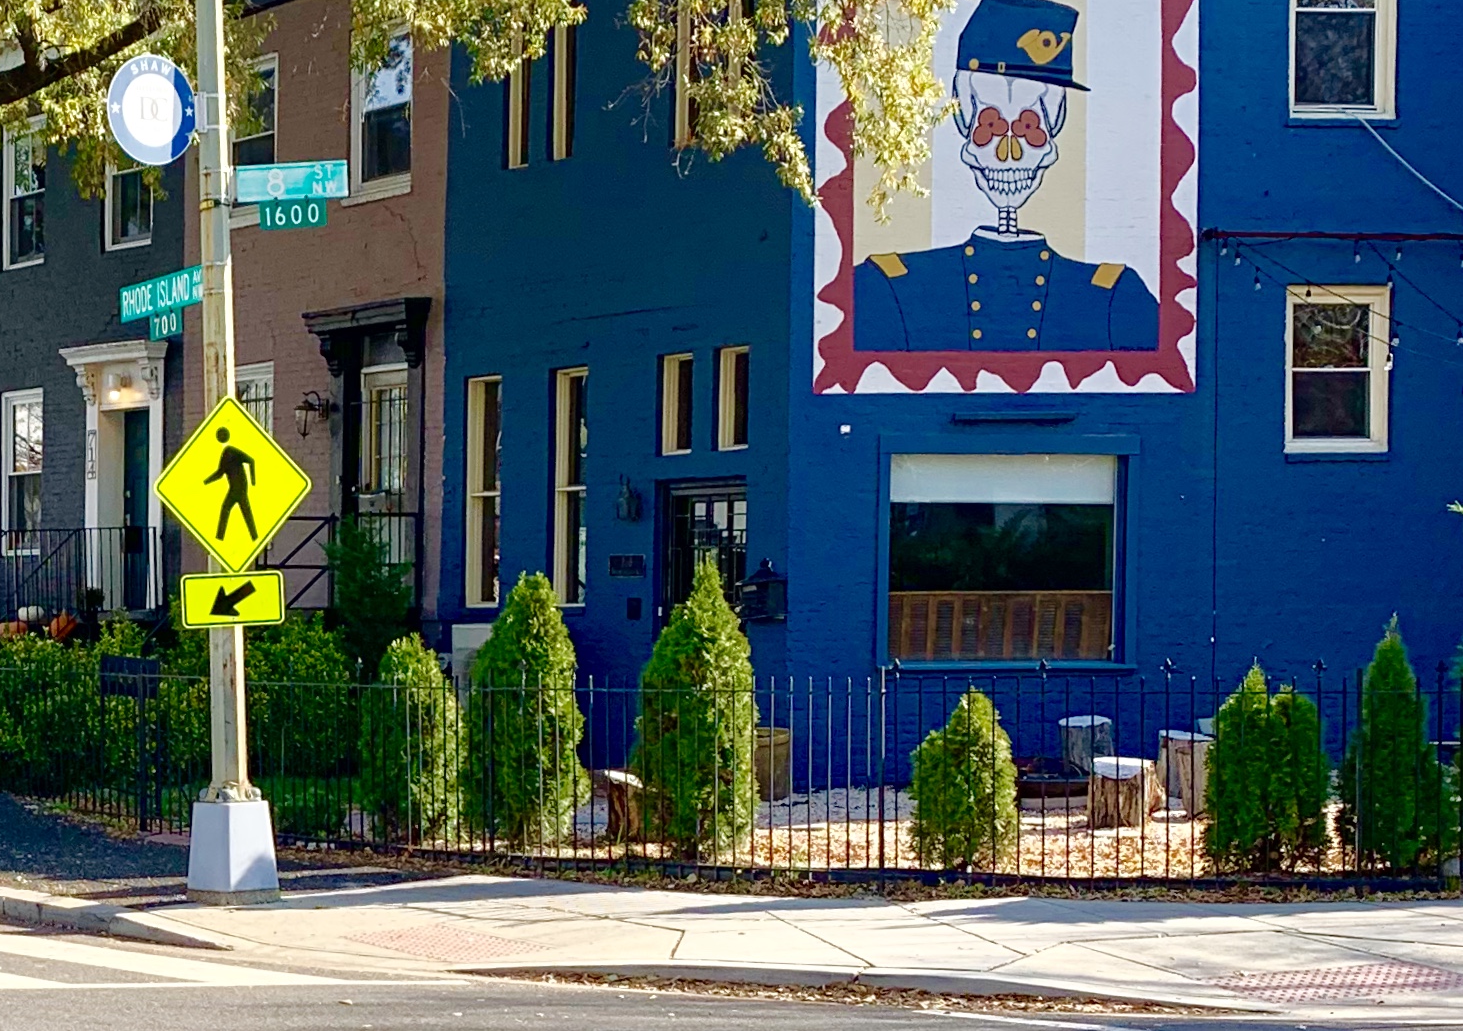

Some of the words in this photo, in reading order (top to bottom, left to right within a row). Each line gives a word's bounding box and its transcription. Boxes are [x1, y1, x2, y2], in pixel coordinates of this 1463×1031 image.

[130, 58, 171, 76] SHAW
[266, 168, 285, 197] 8
[314, 164, 334, 179] ST
[312, 180, 336, 195] NW
[265, 203, 319, 227] 1600
[122, 283, 154, 318] RHODE
[156, 273, 190, 308] ISLAND
[153, 312, 177, 337] 700
